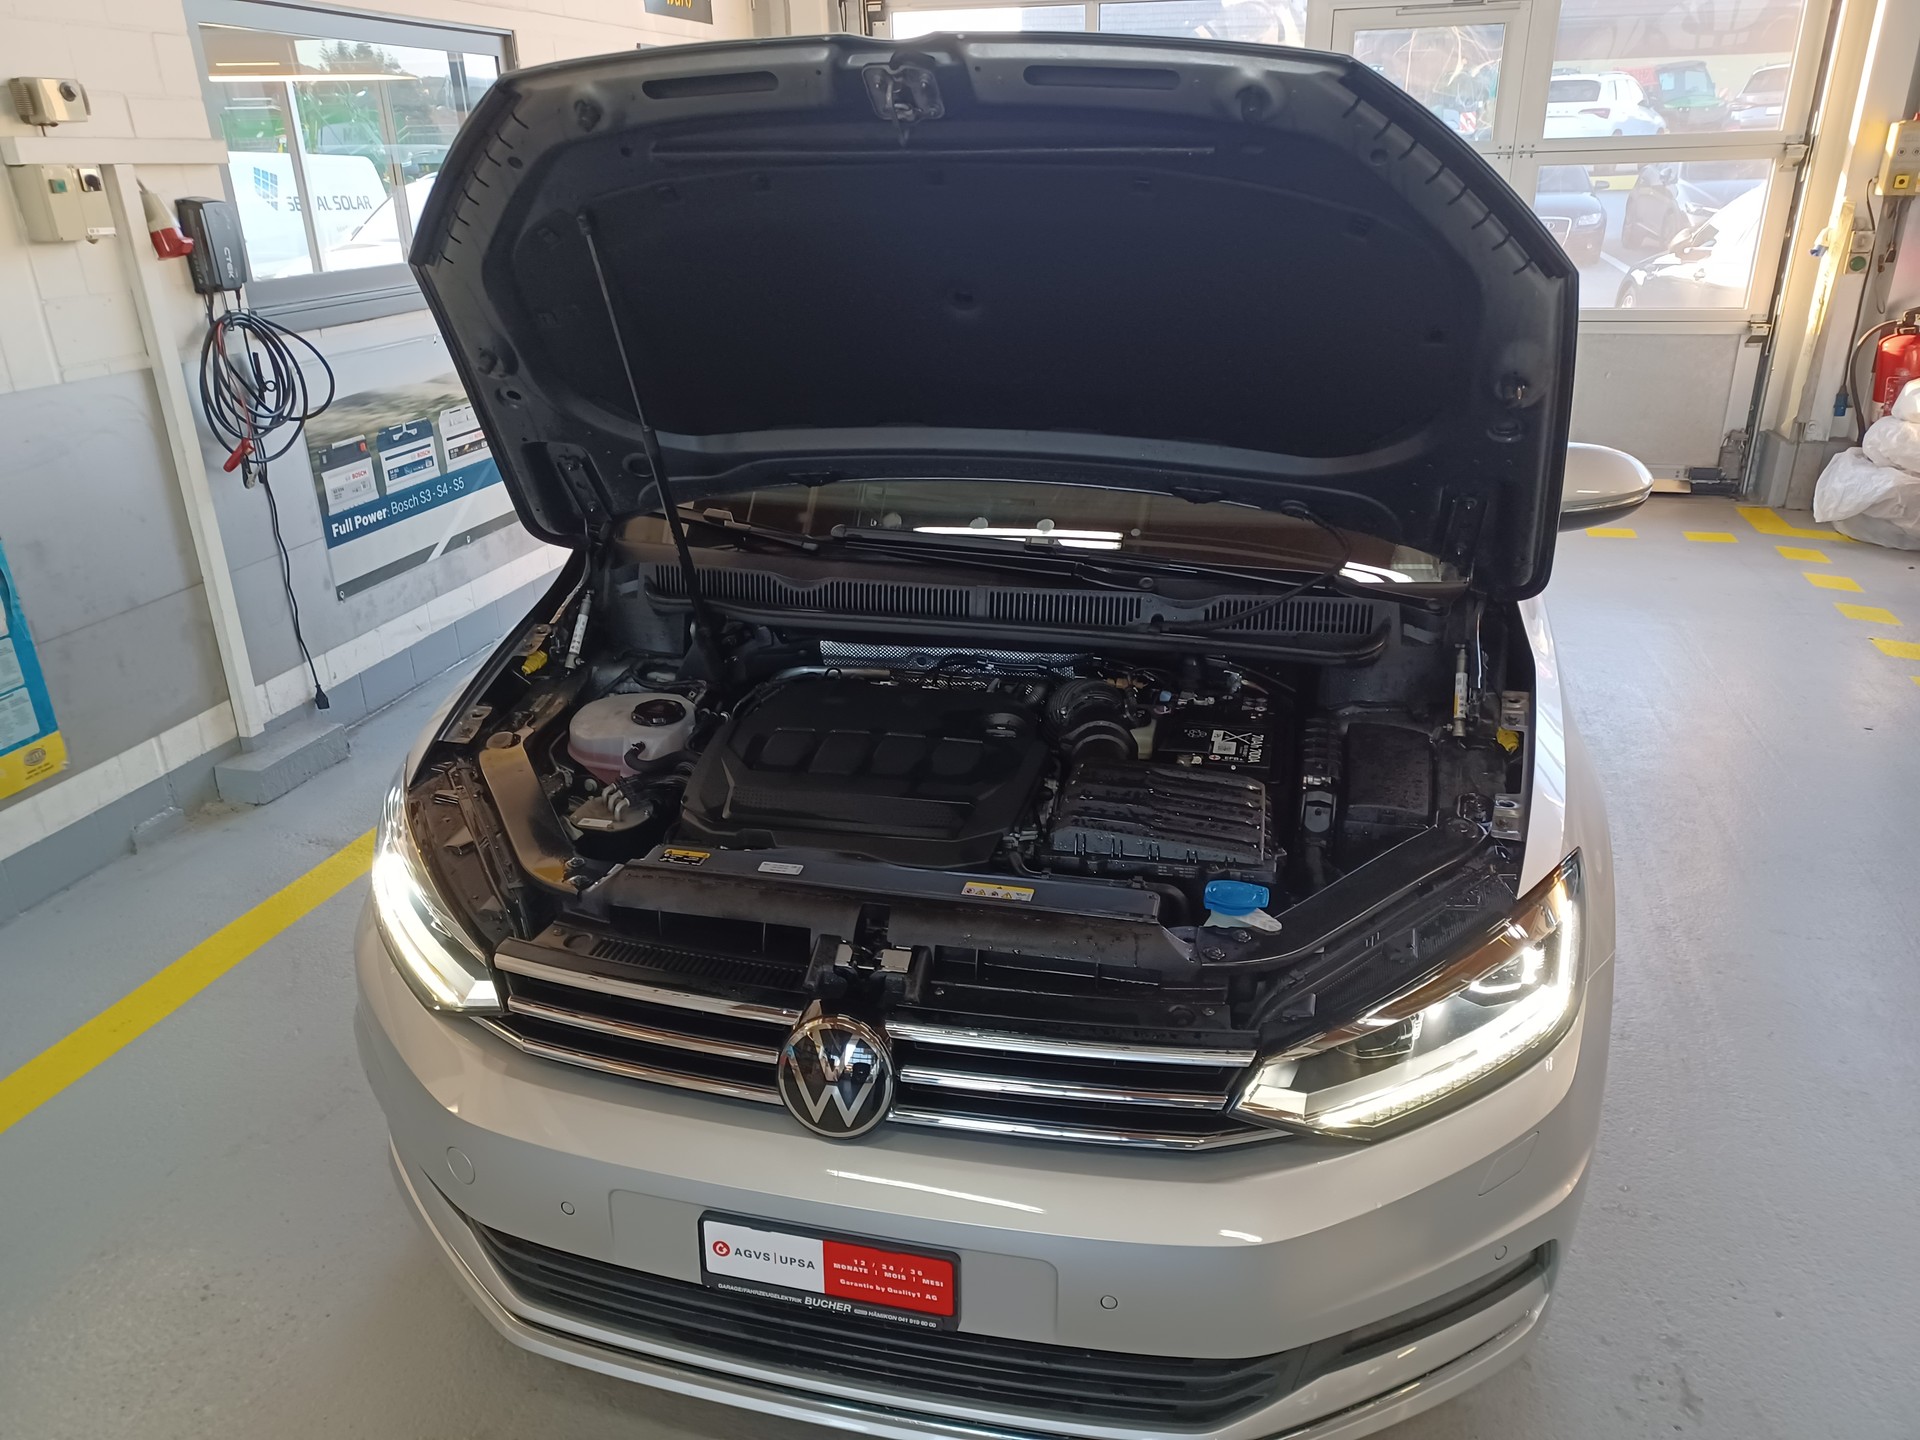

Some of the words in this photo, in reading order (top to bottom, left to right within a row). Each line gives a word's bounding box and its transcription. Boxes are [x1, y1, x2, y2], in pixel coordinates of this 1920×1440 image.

[333, 195, 372, 210] SOLAR
[224, 246, 235, 279] CTEK
[351, 470, 367, 480] BOSCH
[331, 517, 353, 538] Full
[354, 508, 390, 530] Power:
[391, 494, 419, 515] Bosch
[420, 490, 432, 504] S3
[437, 483, 448, 498] S4
[453, 476, 465, 492] S5
[734, 1247, 771, 1262] AGVS
[779, 1255, 815, 1270] UPSA
[854, 1259, 866, 1267] 12
[882, 1263, 894, 1271] 24
[833, 1263, 868, 1274] MONATE
[884, 1272, 906, 1281] MOIS
[922, 1278, 944, 1288] MESI
[840, 1278, 874, 1290] Garantie
[875, 1285, 886, 1293] by
[887, 1287, 920, 1298] Quality1
[804, 1296, 852, 1313] BUCHER
